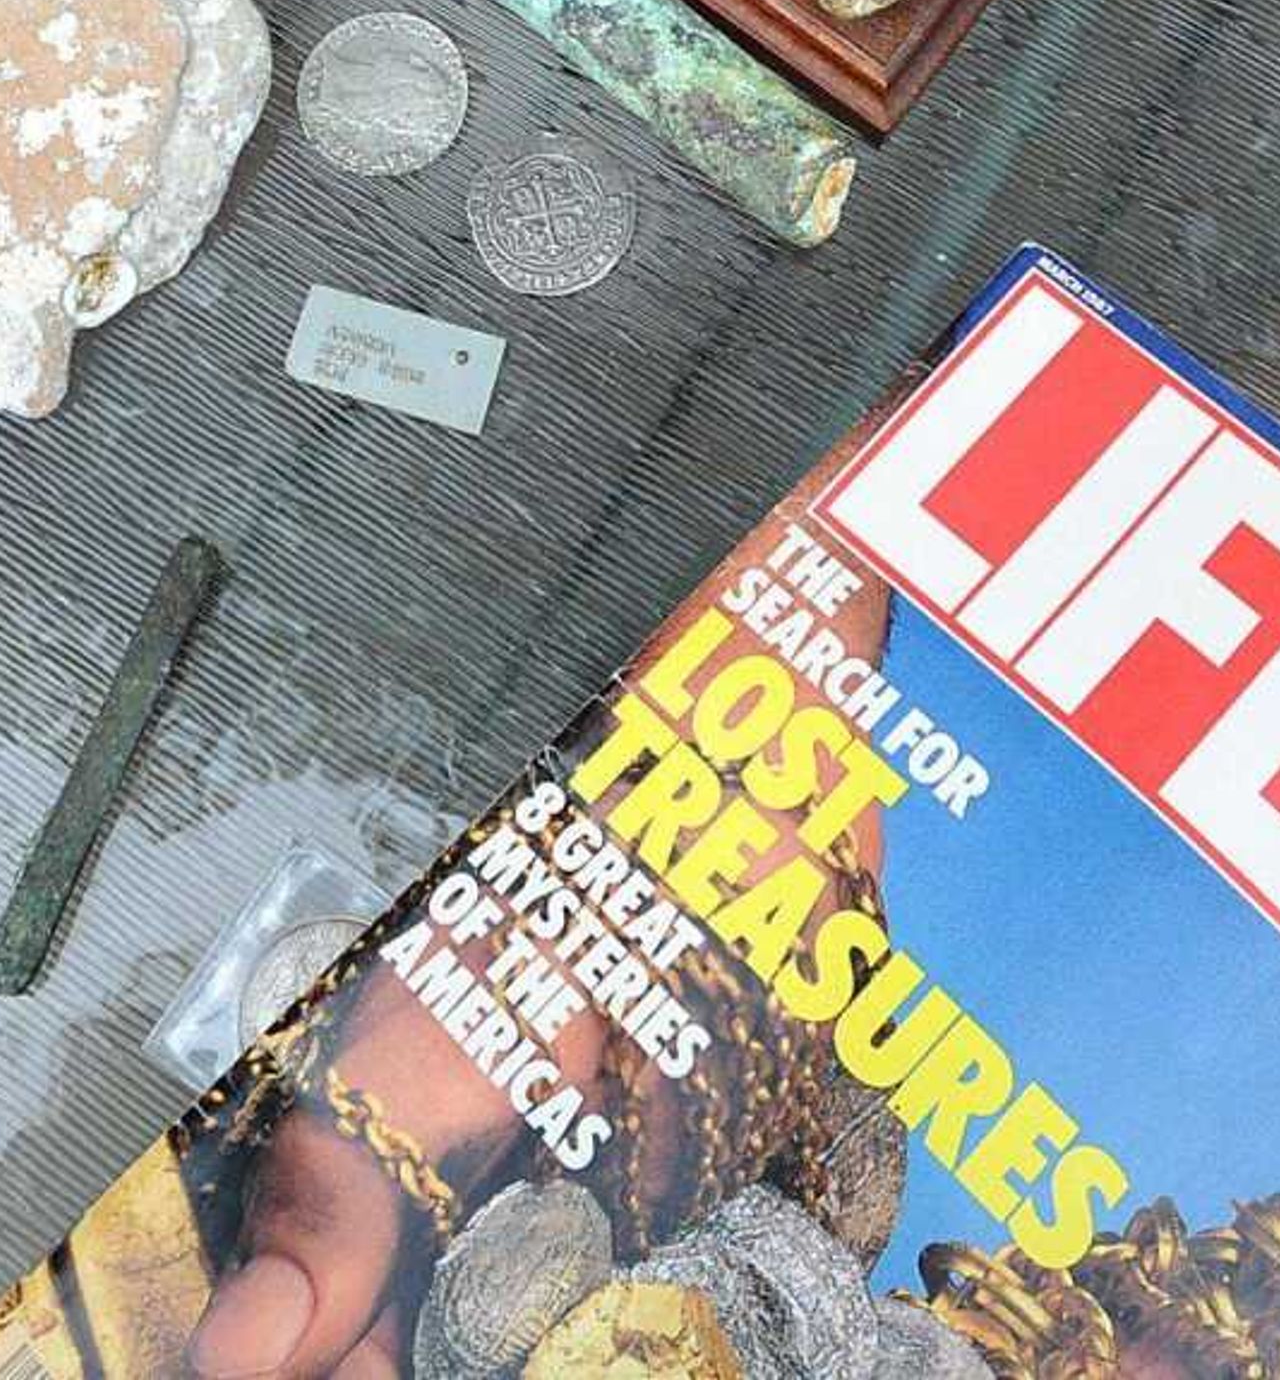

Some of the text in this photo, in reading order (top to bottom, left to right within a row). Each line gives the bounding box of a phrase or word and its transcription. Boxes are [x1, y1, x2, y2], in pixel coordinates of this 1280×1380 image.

[1036, 256, 1115, 316] MARCH 1987
[765, 525, 864, 613] THE
[641, 607, 909, 850] LOST
[723, 568, 989, 820] SEARCH FOR
[428, 872, 589, 1041] OF THE
[468, 824, 710, 1080] MYSTERIES
[515, 781, 707, 971] 8 GREAT
[570, 694, 1130, 1270] TREASURES
[380, 922, 612, 1171] AMERICAS
